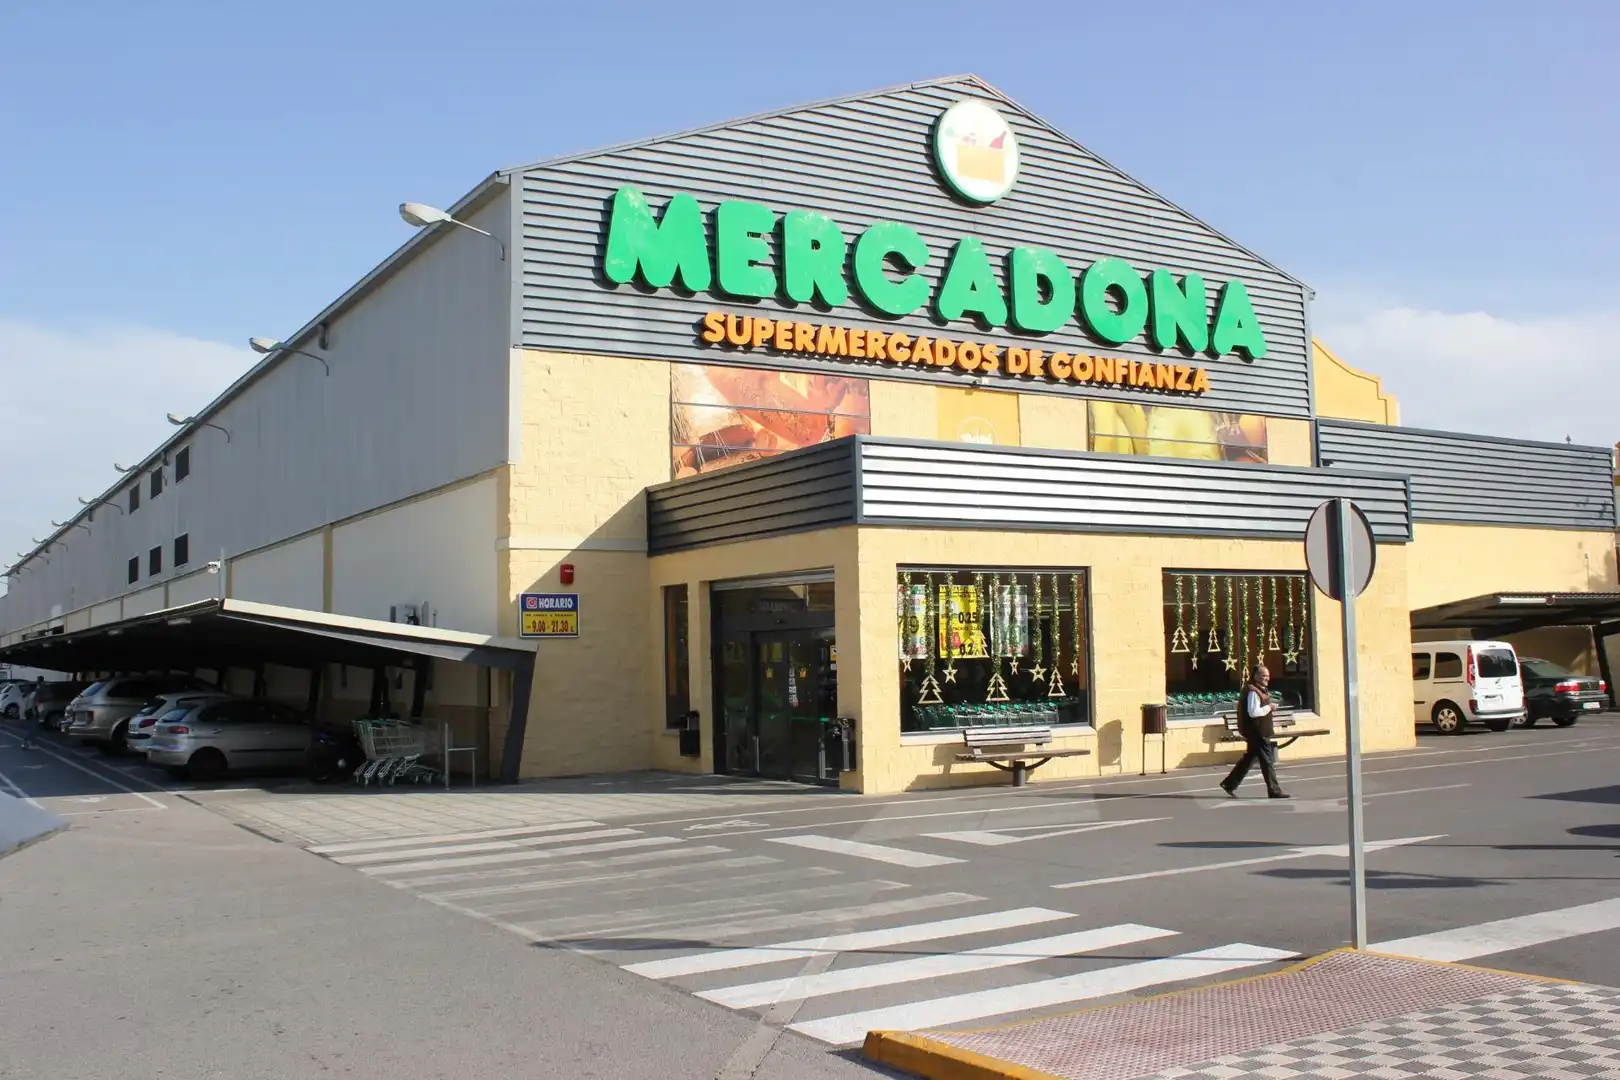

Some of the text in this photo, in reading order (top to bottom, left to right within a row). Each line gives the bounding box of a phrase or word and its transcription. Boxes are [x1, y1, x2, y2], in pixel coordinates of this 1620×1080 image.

[604, 185, 1267, 358] MERCADONA
[702, 311, 1211, 393] SUPERMERCADOS DE CONFIANZA
[532, 620, 546, 632] 9.00
[551, 620, 569, 632] 21.30
[539, 598, 573, 609] HORARIO
